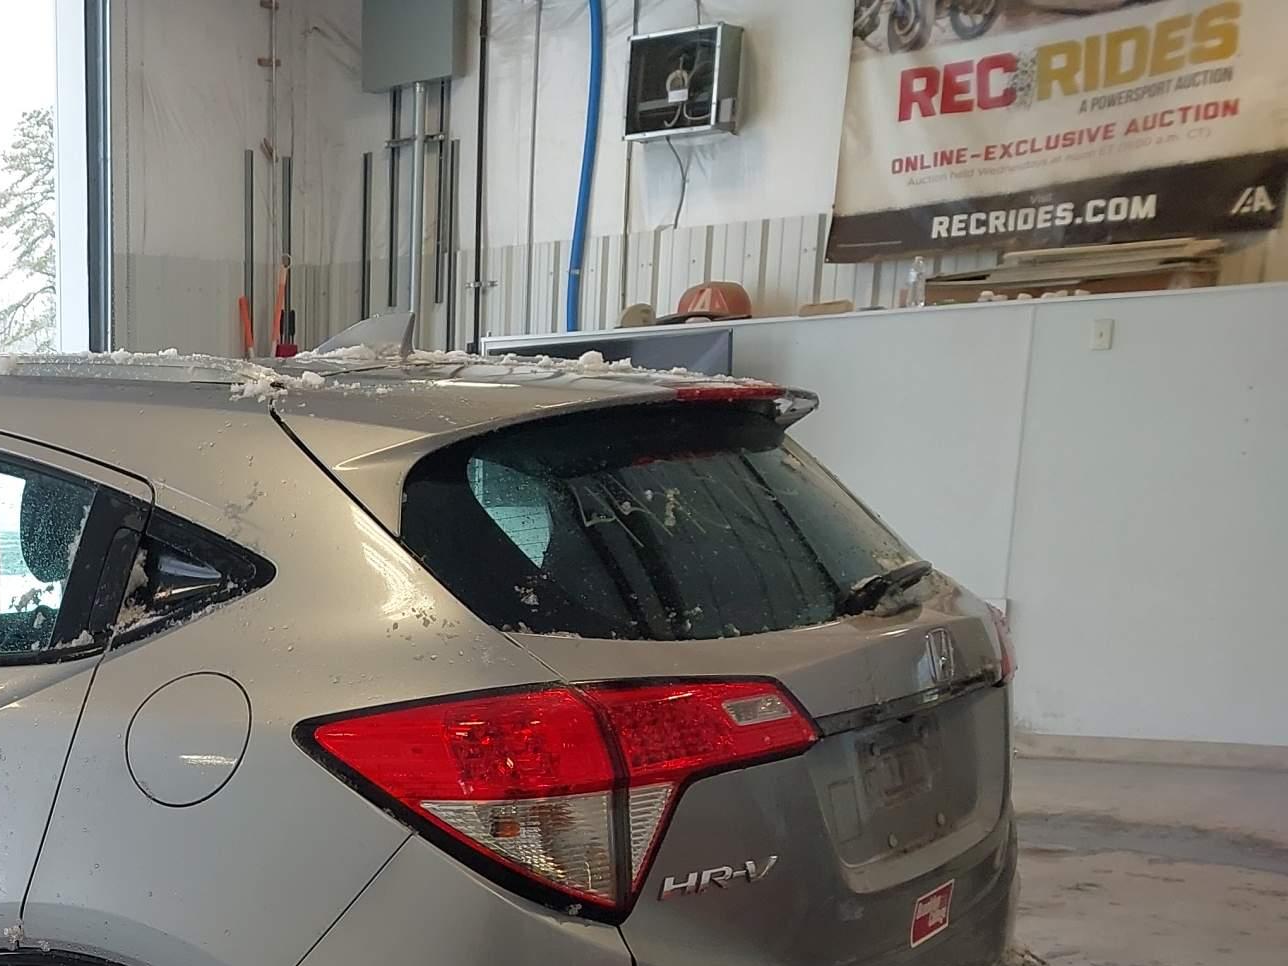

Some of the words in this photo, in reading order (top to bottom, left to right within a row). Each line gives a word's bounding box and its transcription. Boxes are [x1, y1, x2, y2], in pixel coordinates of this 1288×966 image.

[897, 52, 1018, 122] REC
[1036, 1, 1243, 102] RIDES
[1078, 98, 1088, 114] A
[1090, 79, 1172, 113] POWERSPORT
[1174, 66, 1234, 92] AUCTION
[891, 122, 1117, 175] ONLINE-EXCLUSIVE
[1124, 98, 1241, 137] AUCTION
[930, 193, 1158, 240] RECRIDES.COM
[657, 855, 779, 900] HR-V
